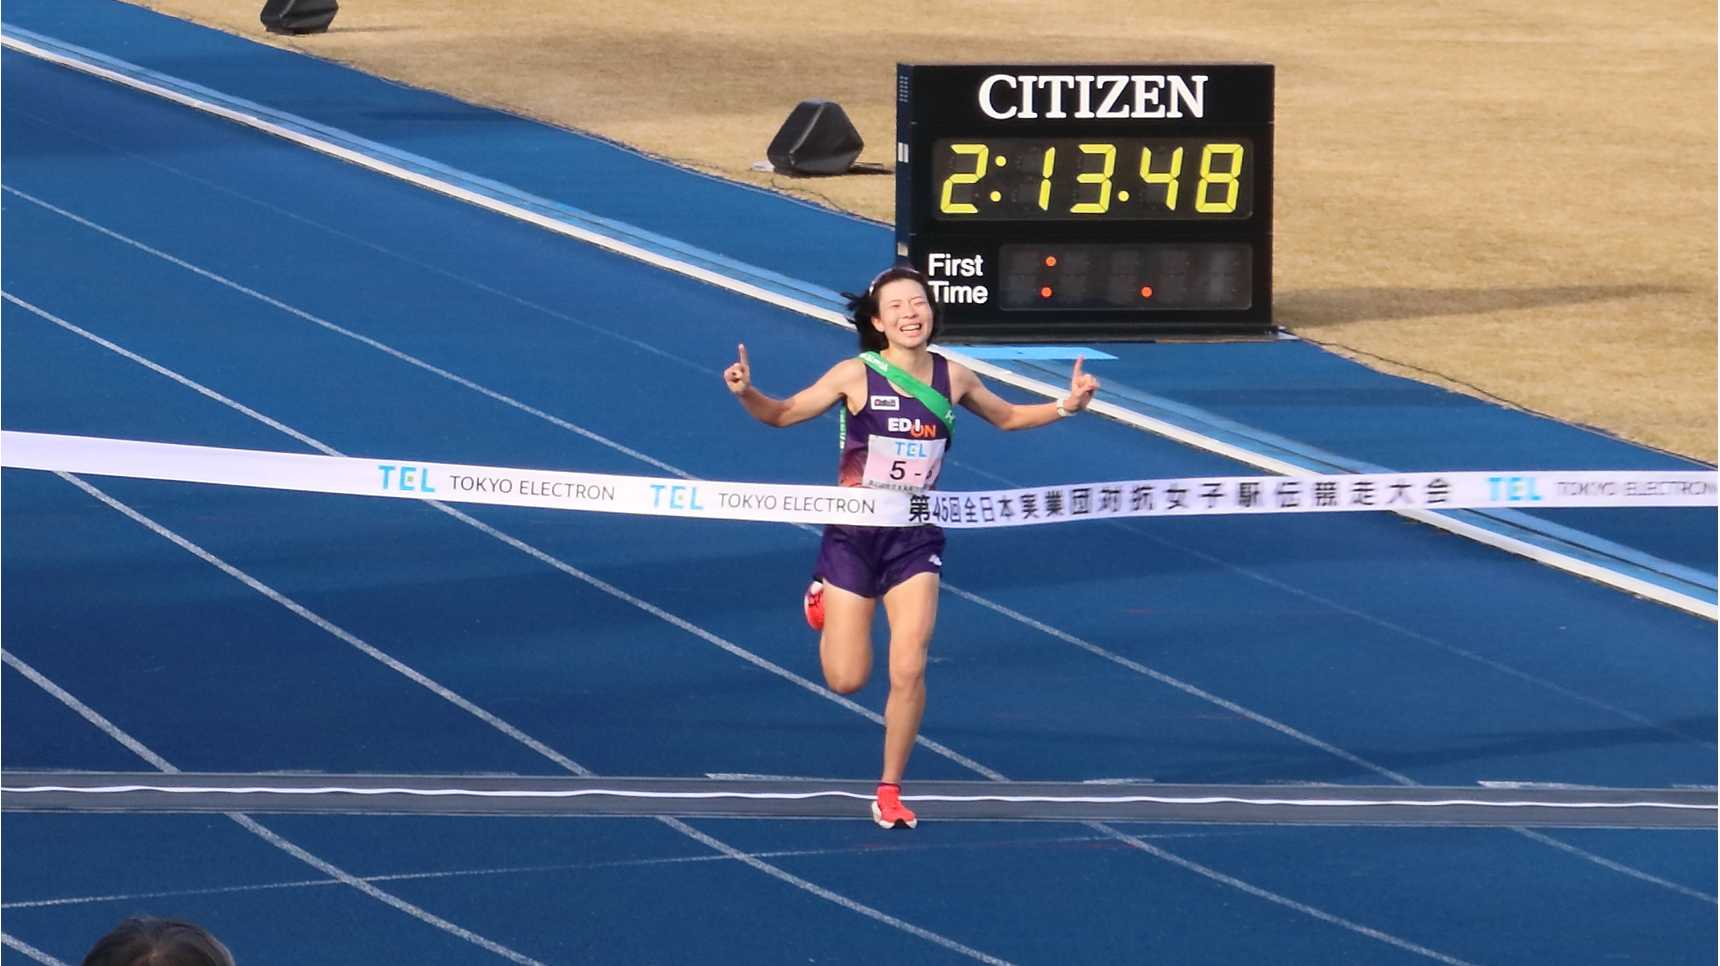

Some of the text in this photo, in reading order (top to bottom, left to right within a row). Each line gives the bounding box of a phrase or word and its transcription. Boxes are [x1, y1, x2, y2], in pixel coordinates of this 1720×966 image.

[978, 74, 1208, 119] CITIZEN
[940, 143, 1245, 214] 2:13.48
[928, 253, 984, 277] First
[929, 281, 988, 304] Time
[887, 417, 936, 437] EDION
[894, 441, 928, 457] TEL
[889, 460, 906, 480] 5
[378, 465, 616, 501] TEL TOKYO ELECTRON
[1487, 477, 1543, 501] TEL
[1555, 481, 1616, 497] TOKYO
[650, 484, 877, 515] TEL TOKYO ELECTRON
